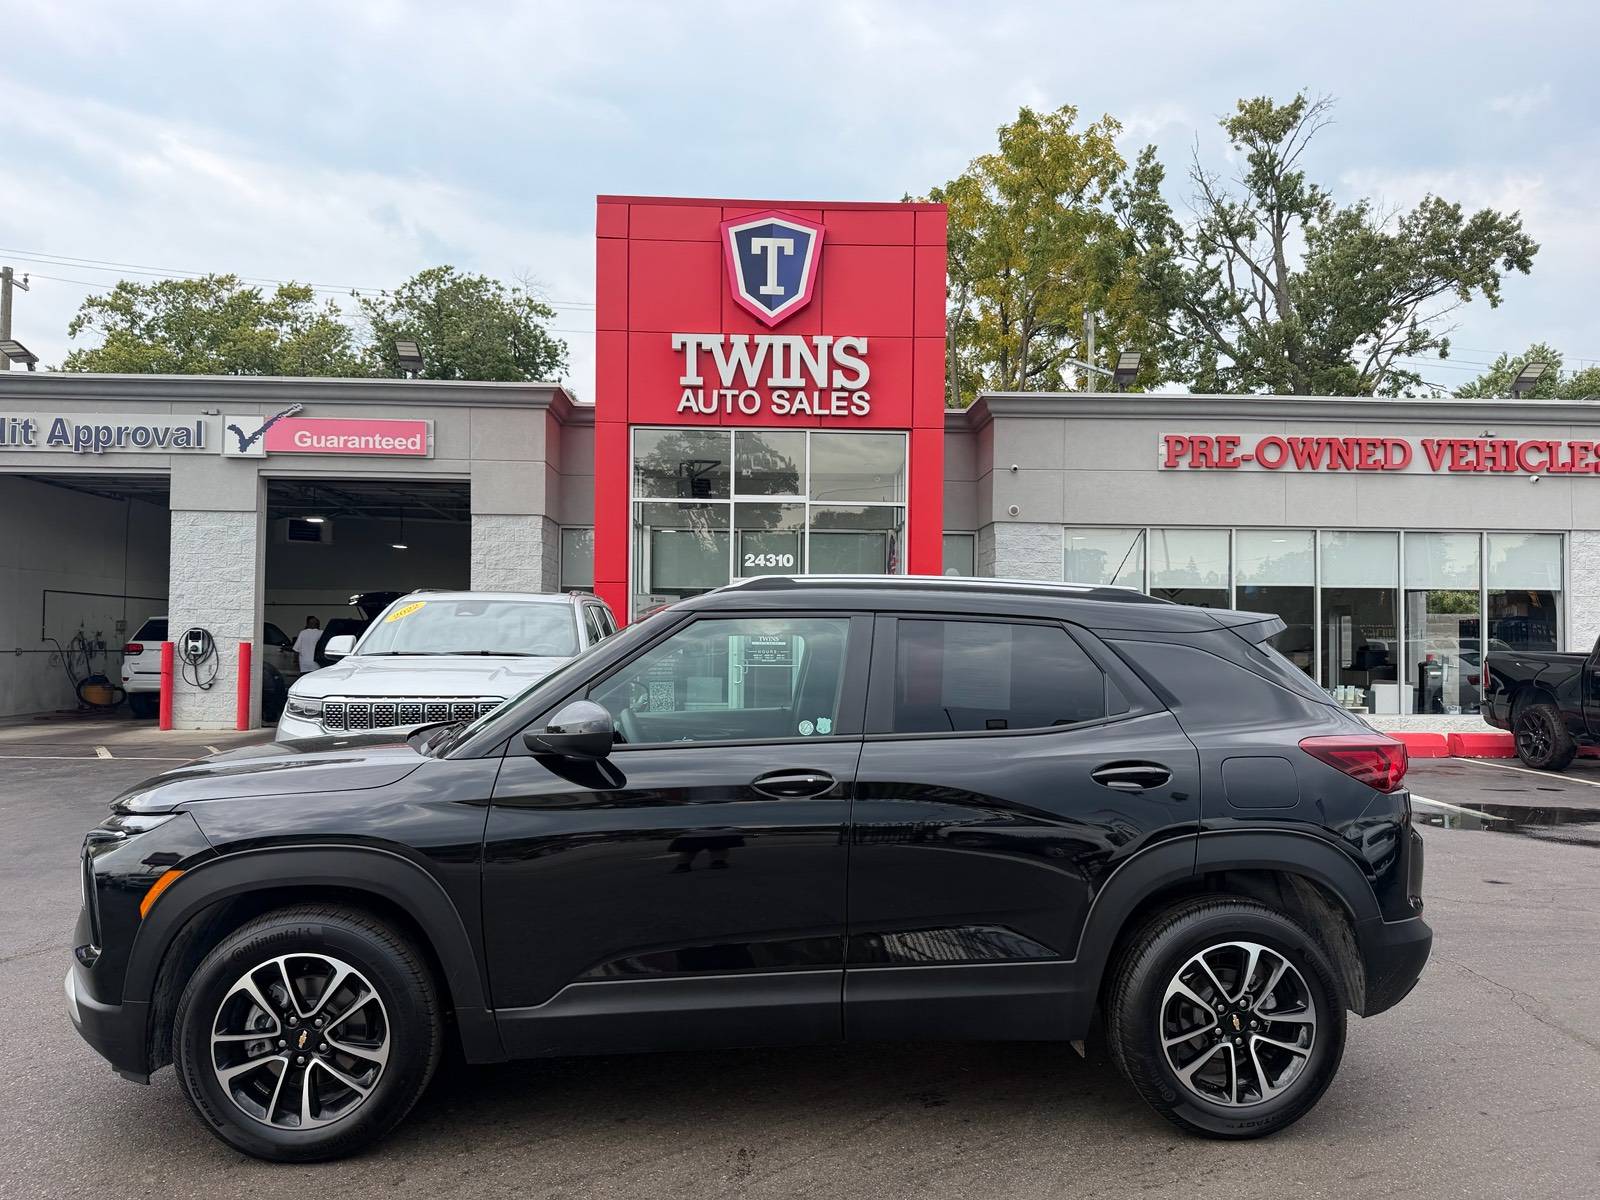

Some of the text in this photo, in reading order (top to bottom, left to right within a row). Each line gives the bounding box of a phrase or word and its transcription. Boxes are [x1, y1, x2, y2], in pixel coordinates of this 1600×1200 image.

[751, 237, 795, 296] T
[671, 333, 871, 391] TWINS
[676, 388, 872, 417] AUTO SALES
[47, 417, 205, 453] Approval
[293, 430, 421, 450] Guaranteed
[1164, 435, 1413, 471] PRE-OWNED
[744, 553, 794, 567] 24310
